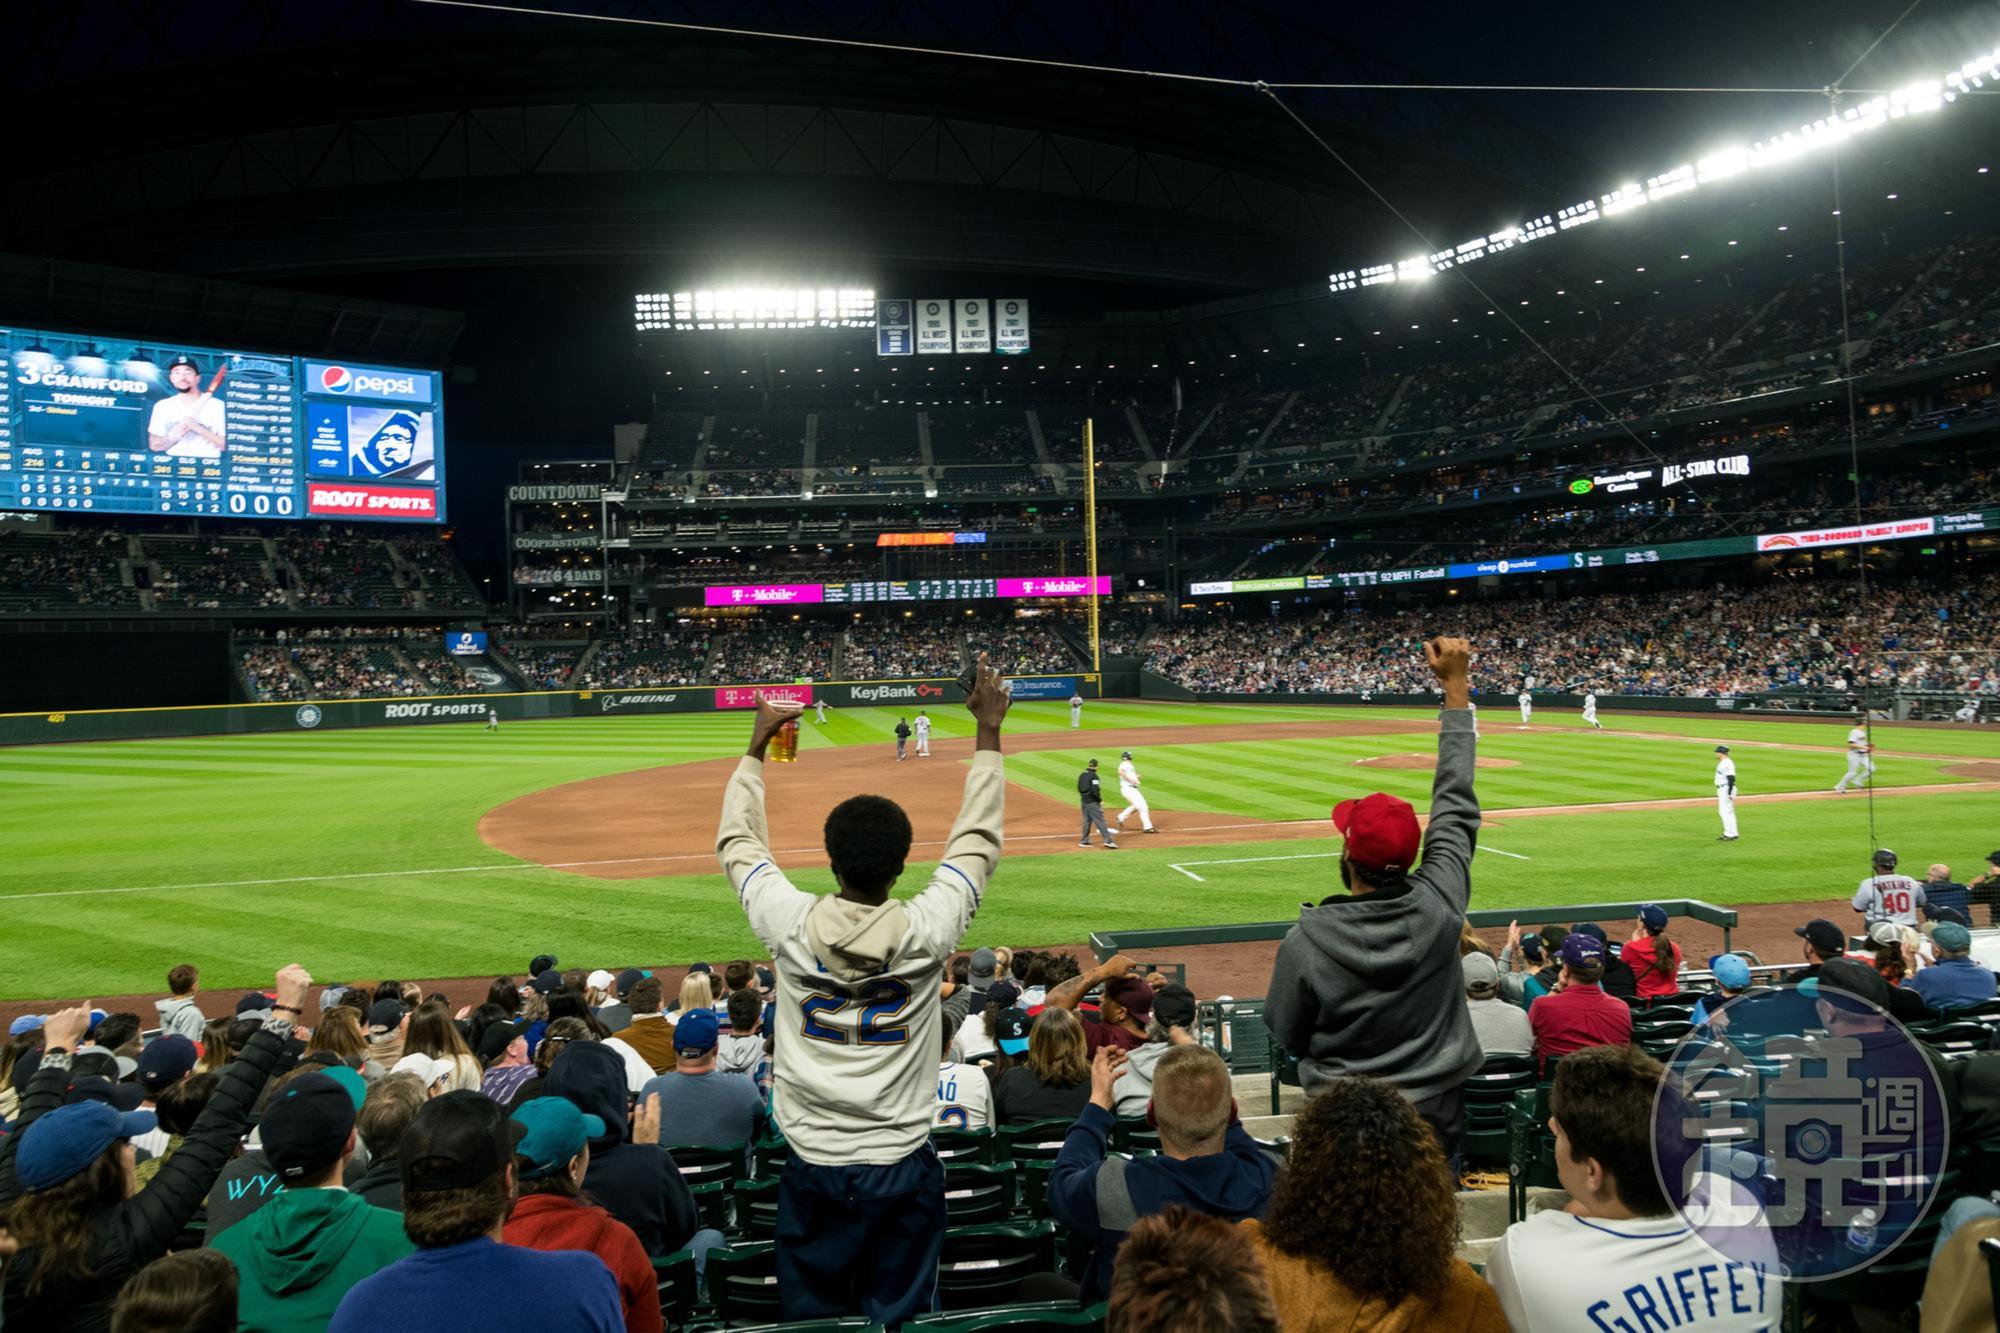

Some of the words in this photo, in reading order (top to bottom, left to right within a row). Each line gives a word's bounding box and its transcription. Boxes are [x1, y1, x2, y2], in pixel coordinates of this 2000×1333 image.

[16, 361, 41, 384] 3
[41, 373, 149, 394] CRAWFORD
[355, 375, 416, 395] pepsi
[51, 392, 118, 407] TONIGHT
[1661, 460, 1716, 487] ALL-STAR
[1716, 454, 1750, 475] CLUB
[22, 474, 29, 482] 1
[37, 474, 46, 483] 2
[52, 475, 61, 483] 3
[67, 476, 76, 484] 4
[82, 476, 91, 485] 5
[97, 477, 106, 486] 6
[112, 478, 121, 486] 7
[127, 479, 136, 487] 8
[141, 479, 150, 488] 9
[37, 483, 47, 494] 5
[67, 485, 77, 495] 2
[509, 484, 600, 500] COUNTDOWN
[229, 493, 247, 513] 0
[253, 495, 270, 514] 0
[276, 496, 293, 515] 0
[312, 490, 368, 508] ROOT
[196, 503, 203, 513] 1
[210, 503, 220, 513] 2
[1942, 515, 1967, 523] Tampa
[1967, 512, 1983, 521] Bay
[1866, 526, 1893, 537] FAMILY
[1952, 522, 1985, 531] Yankees
[515, 536, 598, 548] COOPERSTOWN
[1477, 564, 1497, 572] sleep
[1509, 560, 1537, 568] number
[574, 570, 602, 581] DAYS
[1392, 571, 1411, 580] MPH
[1414, 568, 1445, 579] Fastball
[1024, 681, 1063, 690] Insurance
[620, 694, 677, 704] BOEING
[850, 685, 918, 701] KeyBank
[385, 703, 432, 718] ROOT
[432, 703, 487, 716] SPORTS
[1883, 892, 1910, 916] 40
[799, 976, 911, 1045] 22
[1012, 1022, 1023, 1036] S
[1586, 1260, 1766, 1333] GRIFFEY
